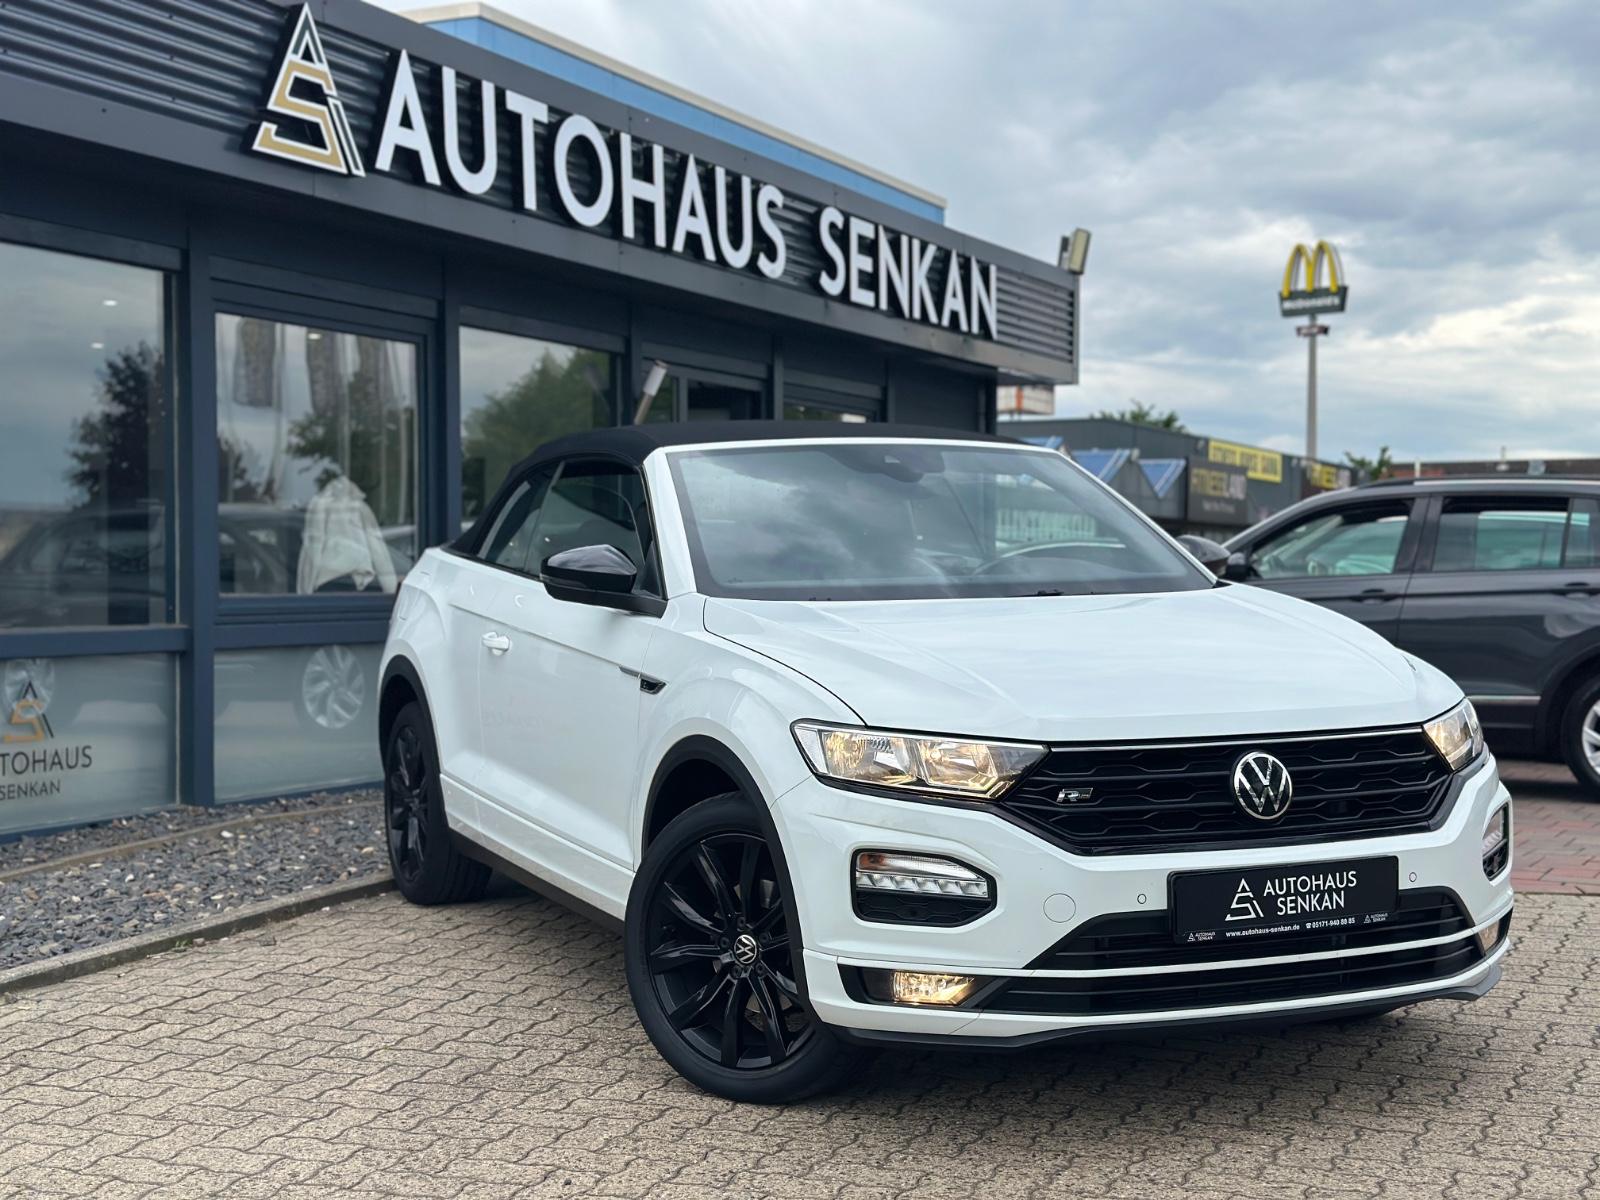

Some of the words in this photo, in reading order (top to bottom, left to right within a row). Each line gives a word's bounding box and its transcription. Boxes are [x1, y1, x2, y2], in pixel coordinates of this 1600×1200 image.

[375, 49, 786, 279] AUTOHAUS
[819, 206, 998, 340] SENKAN
[1263, 871, 1357, 897] AUTOHAUS
[1276, 890, 1345, 916] SENKAN
[1225, 924, 1300, 938] www.autohaus-senkan.de
